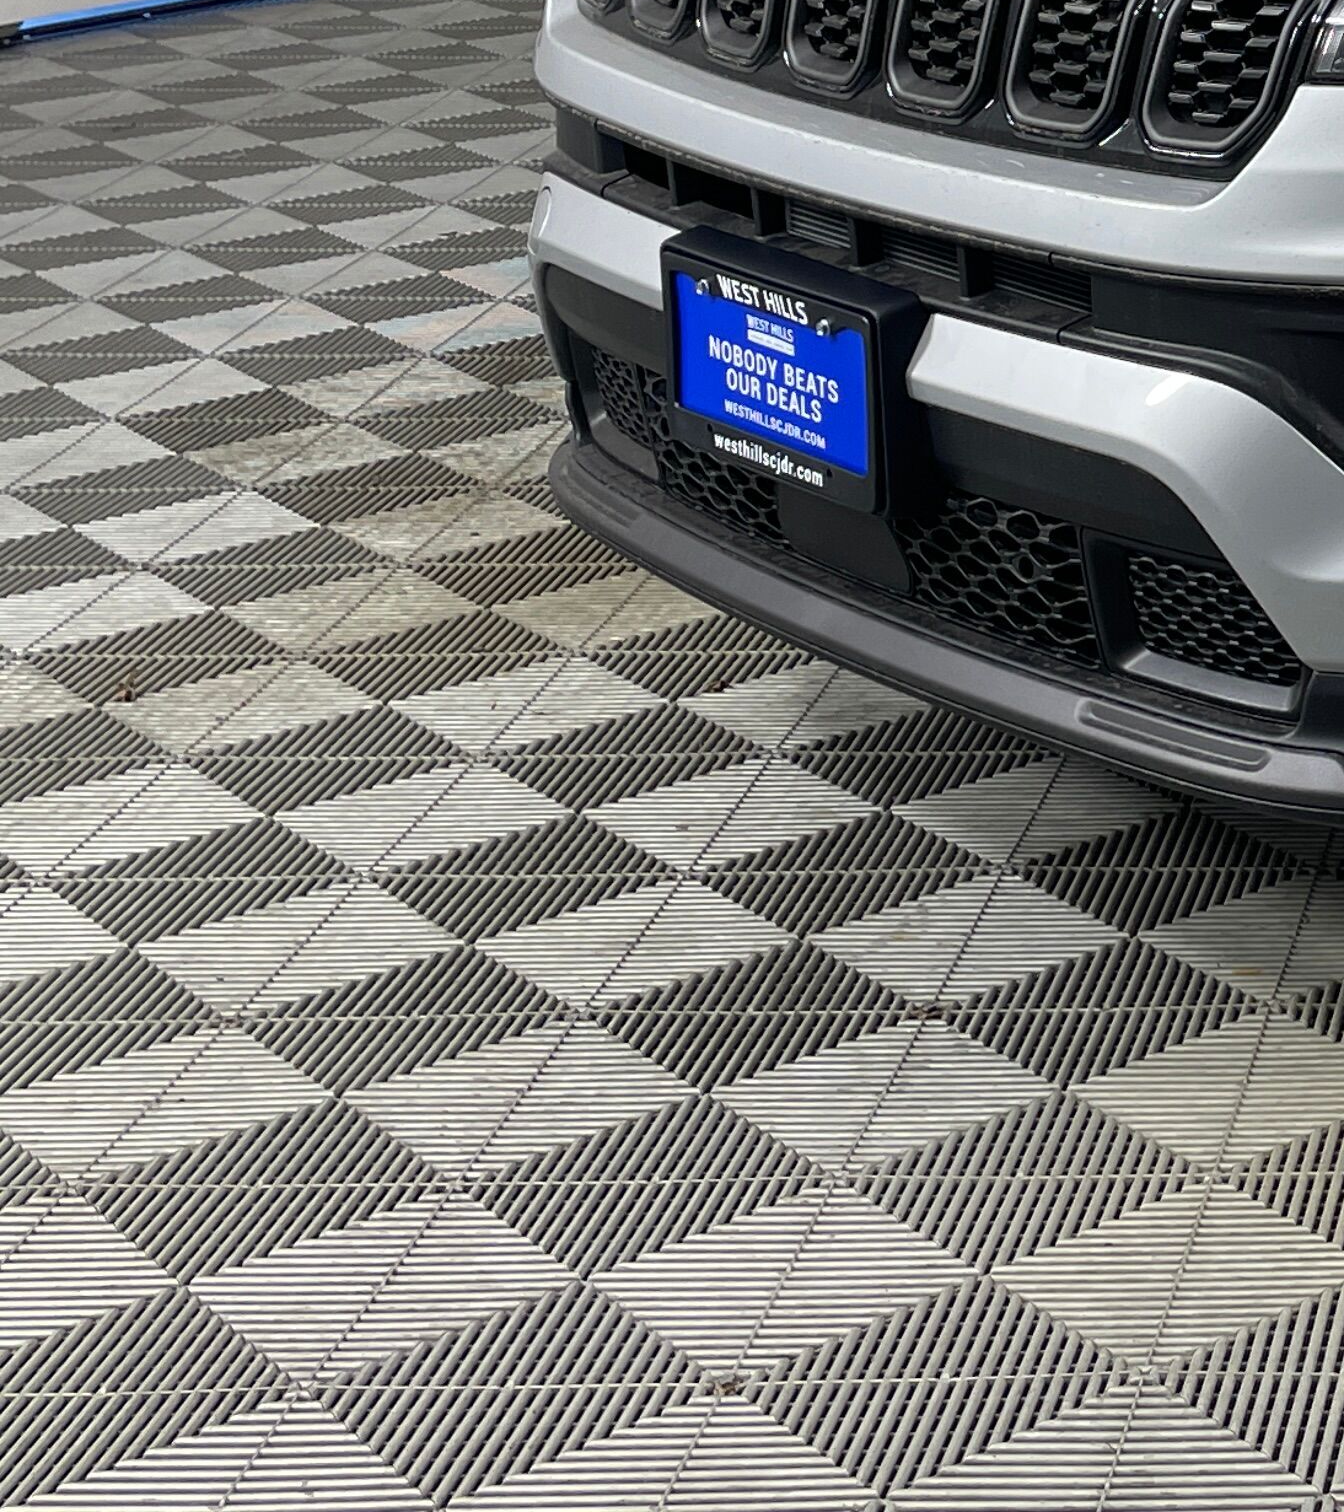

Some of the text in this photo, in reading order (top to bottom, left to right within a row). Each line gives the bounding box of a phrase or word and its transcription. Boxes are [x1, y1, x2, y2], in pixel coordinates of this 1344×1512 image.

[716, 274, 808, 325] WEST HILLS
[746, 313, 770, 333] WEST
[770, 322, 794, 343] HILLS
[708, 334, 778, 380] NOBODY
[783, 364, 839, 403] BEATS
[726, 368, 822, 422] OUR DEALS
[724, 399, 826, 450] WESTHILLSCJDR.COM
[714, 433, 823, 487] westhillscjdr.com
